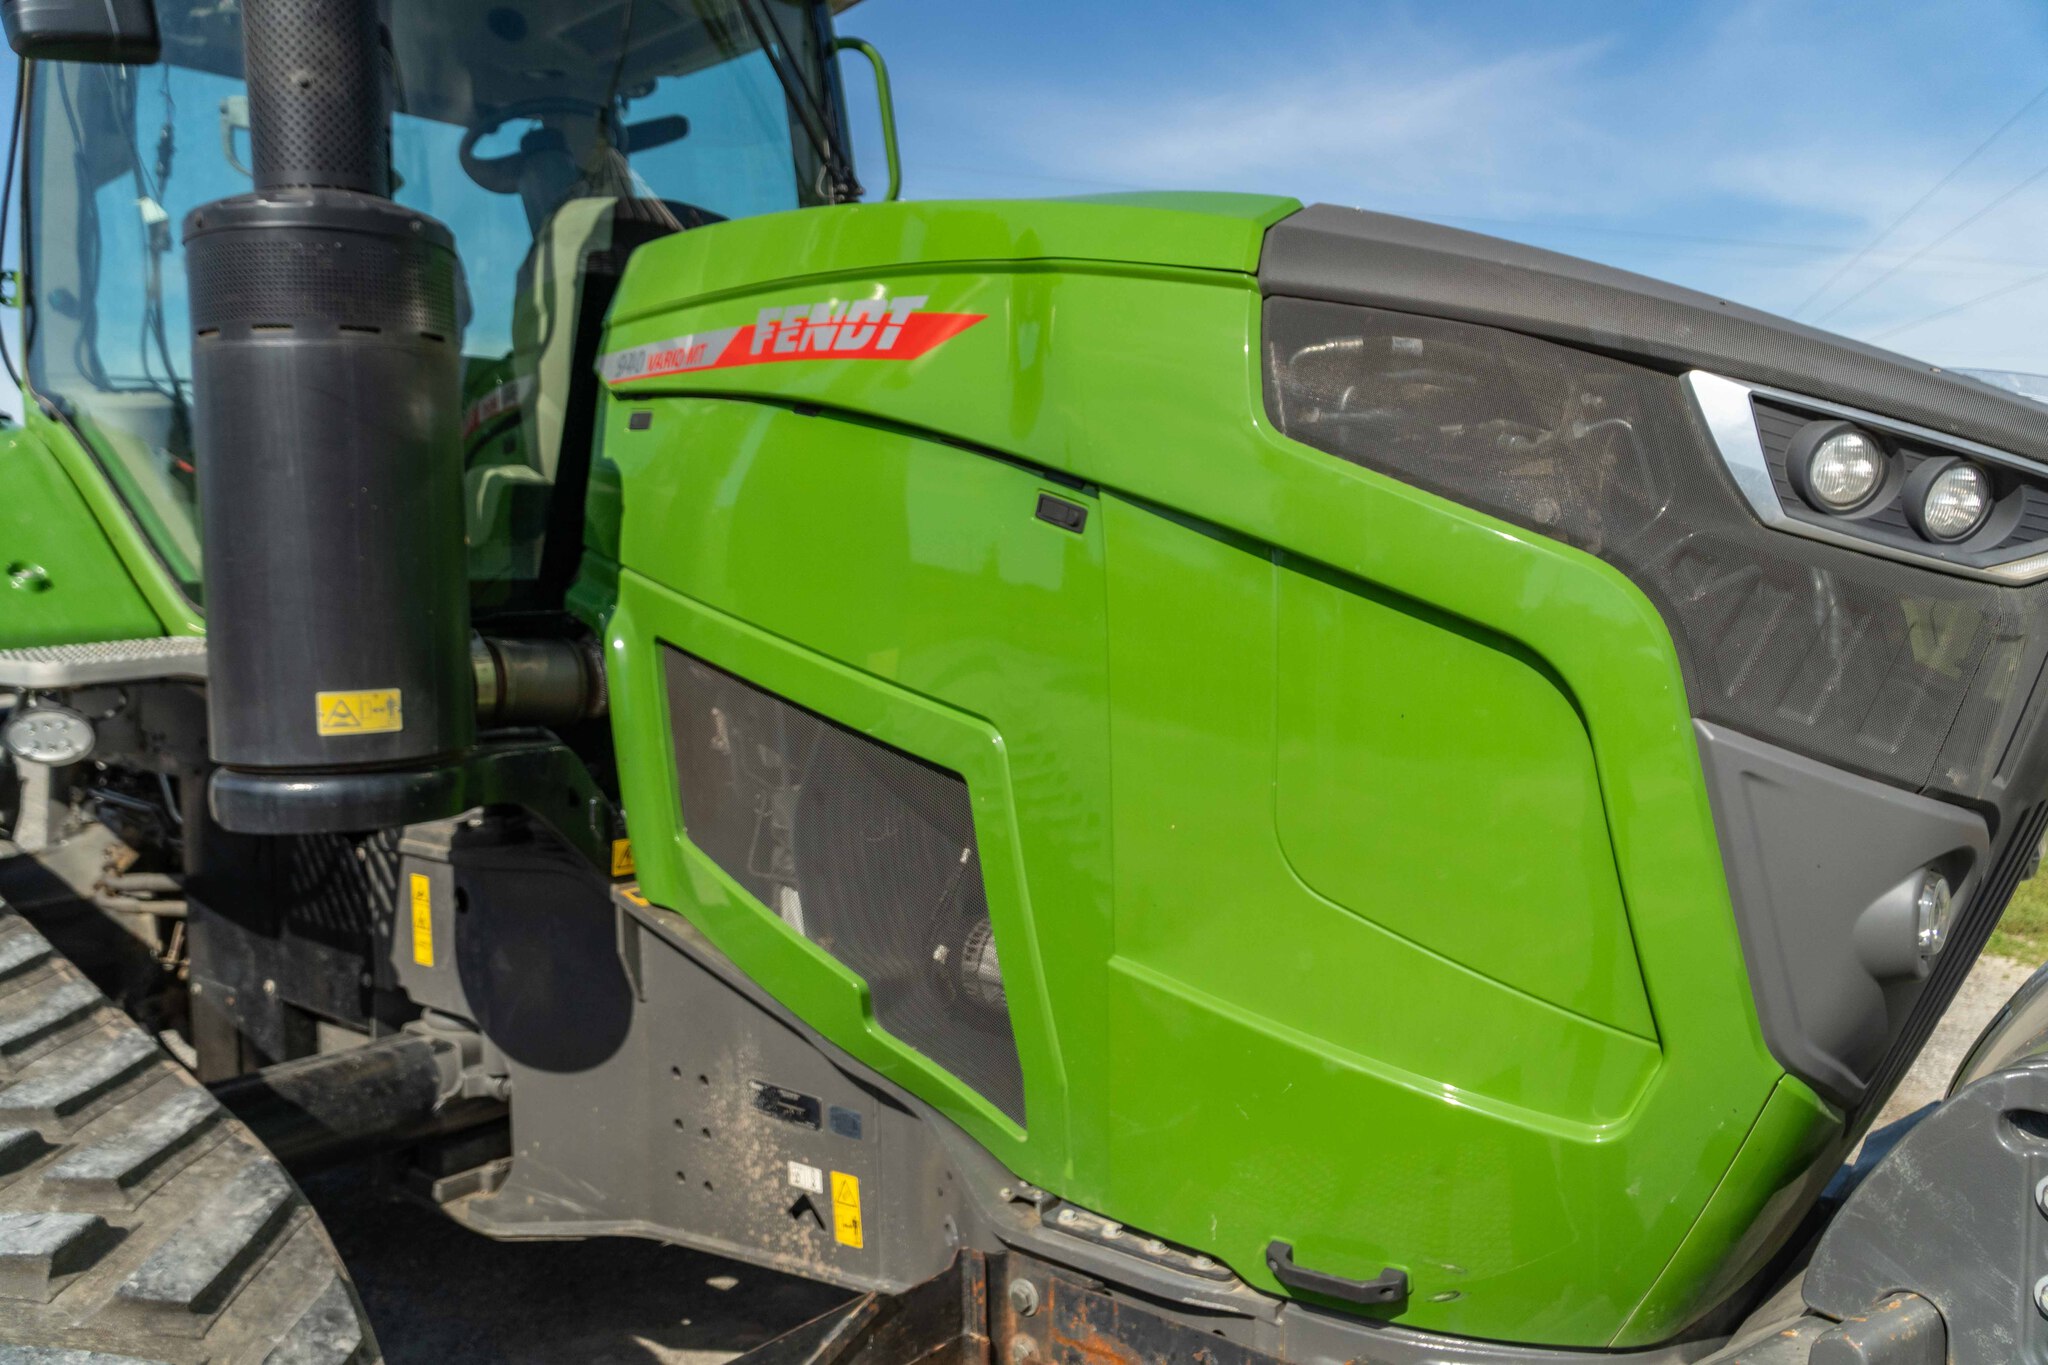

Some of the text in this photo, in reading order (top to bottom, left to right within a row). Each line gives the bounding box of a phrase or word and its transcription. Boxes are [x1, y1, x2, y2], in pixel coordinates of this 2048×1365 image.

[750, 295, 929, 355] FENDT
[647, 347, 687, 371] VARIO
[686, 342, 708, 366] MT
